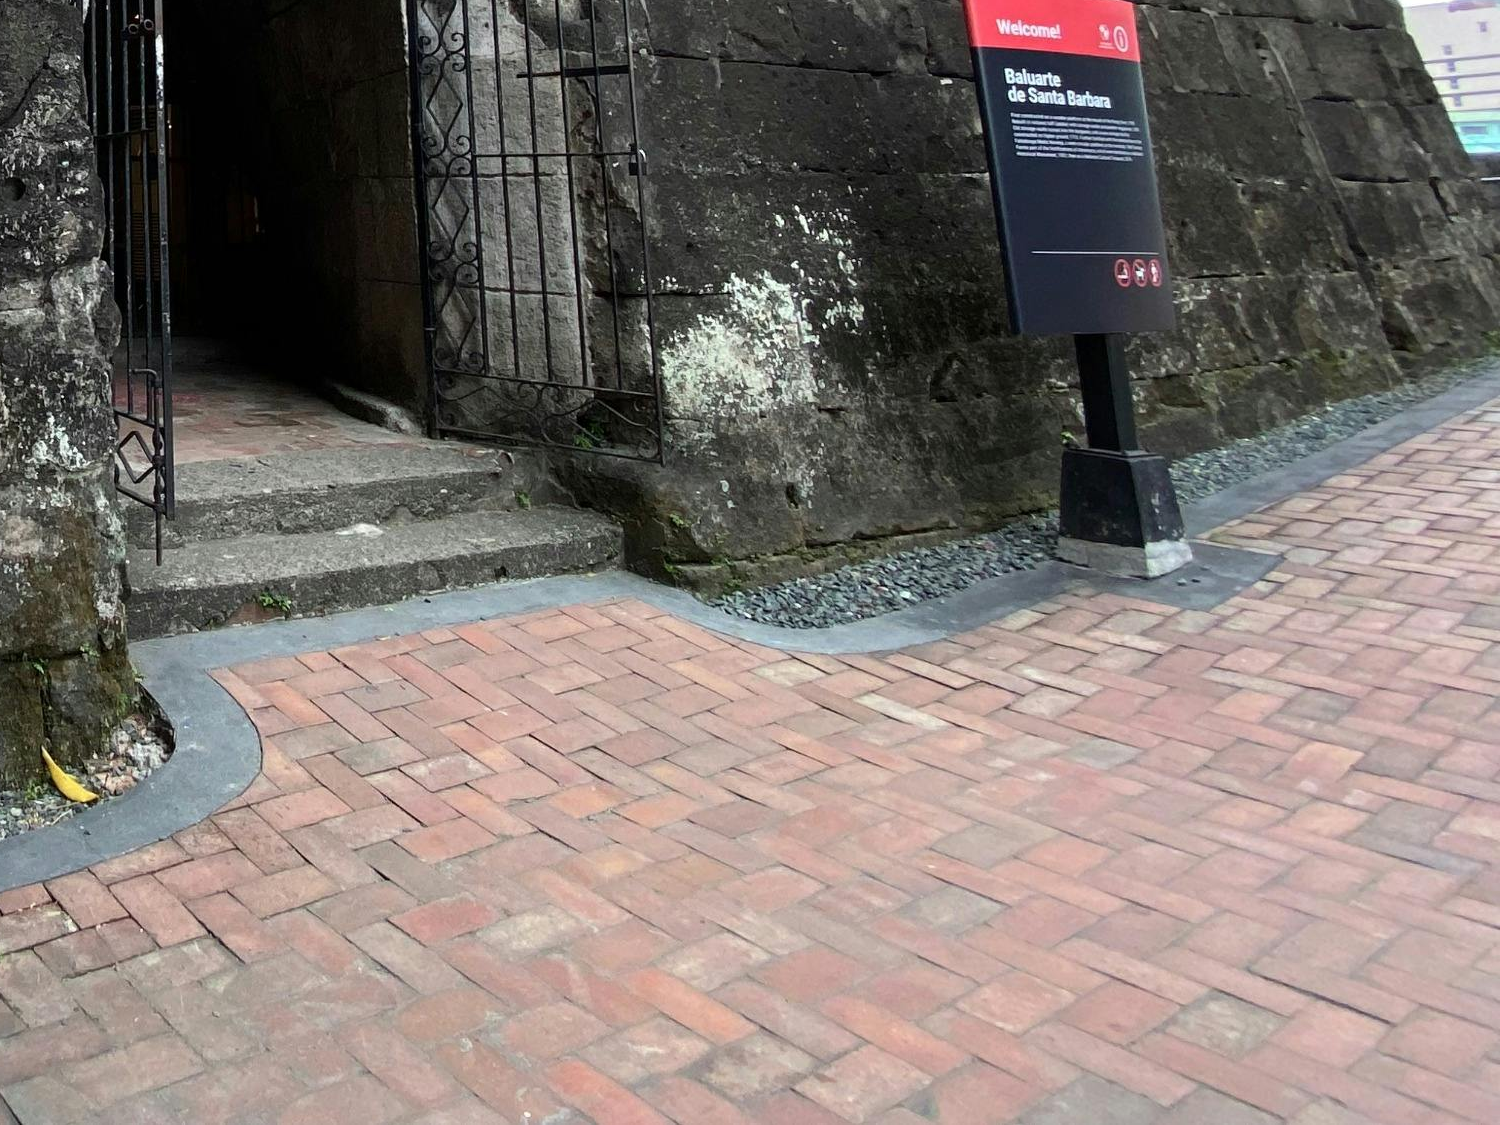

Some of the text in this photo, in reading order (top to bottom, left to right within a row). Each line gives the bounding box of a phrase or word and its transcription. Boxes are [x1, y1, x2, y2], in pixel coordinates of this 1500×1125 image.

[996, 19, 1062, 39] Welcome!
[1004, 68, 1061, 87] Baluarte
[1007, 86, 1111, 108] de Santa Barbara
